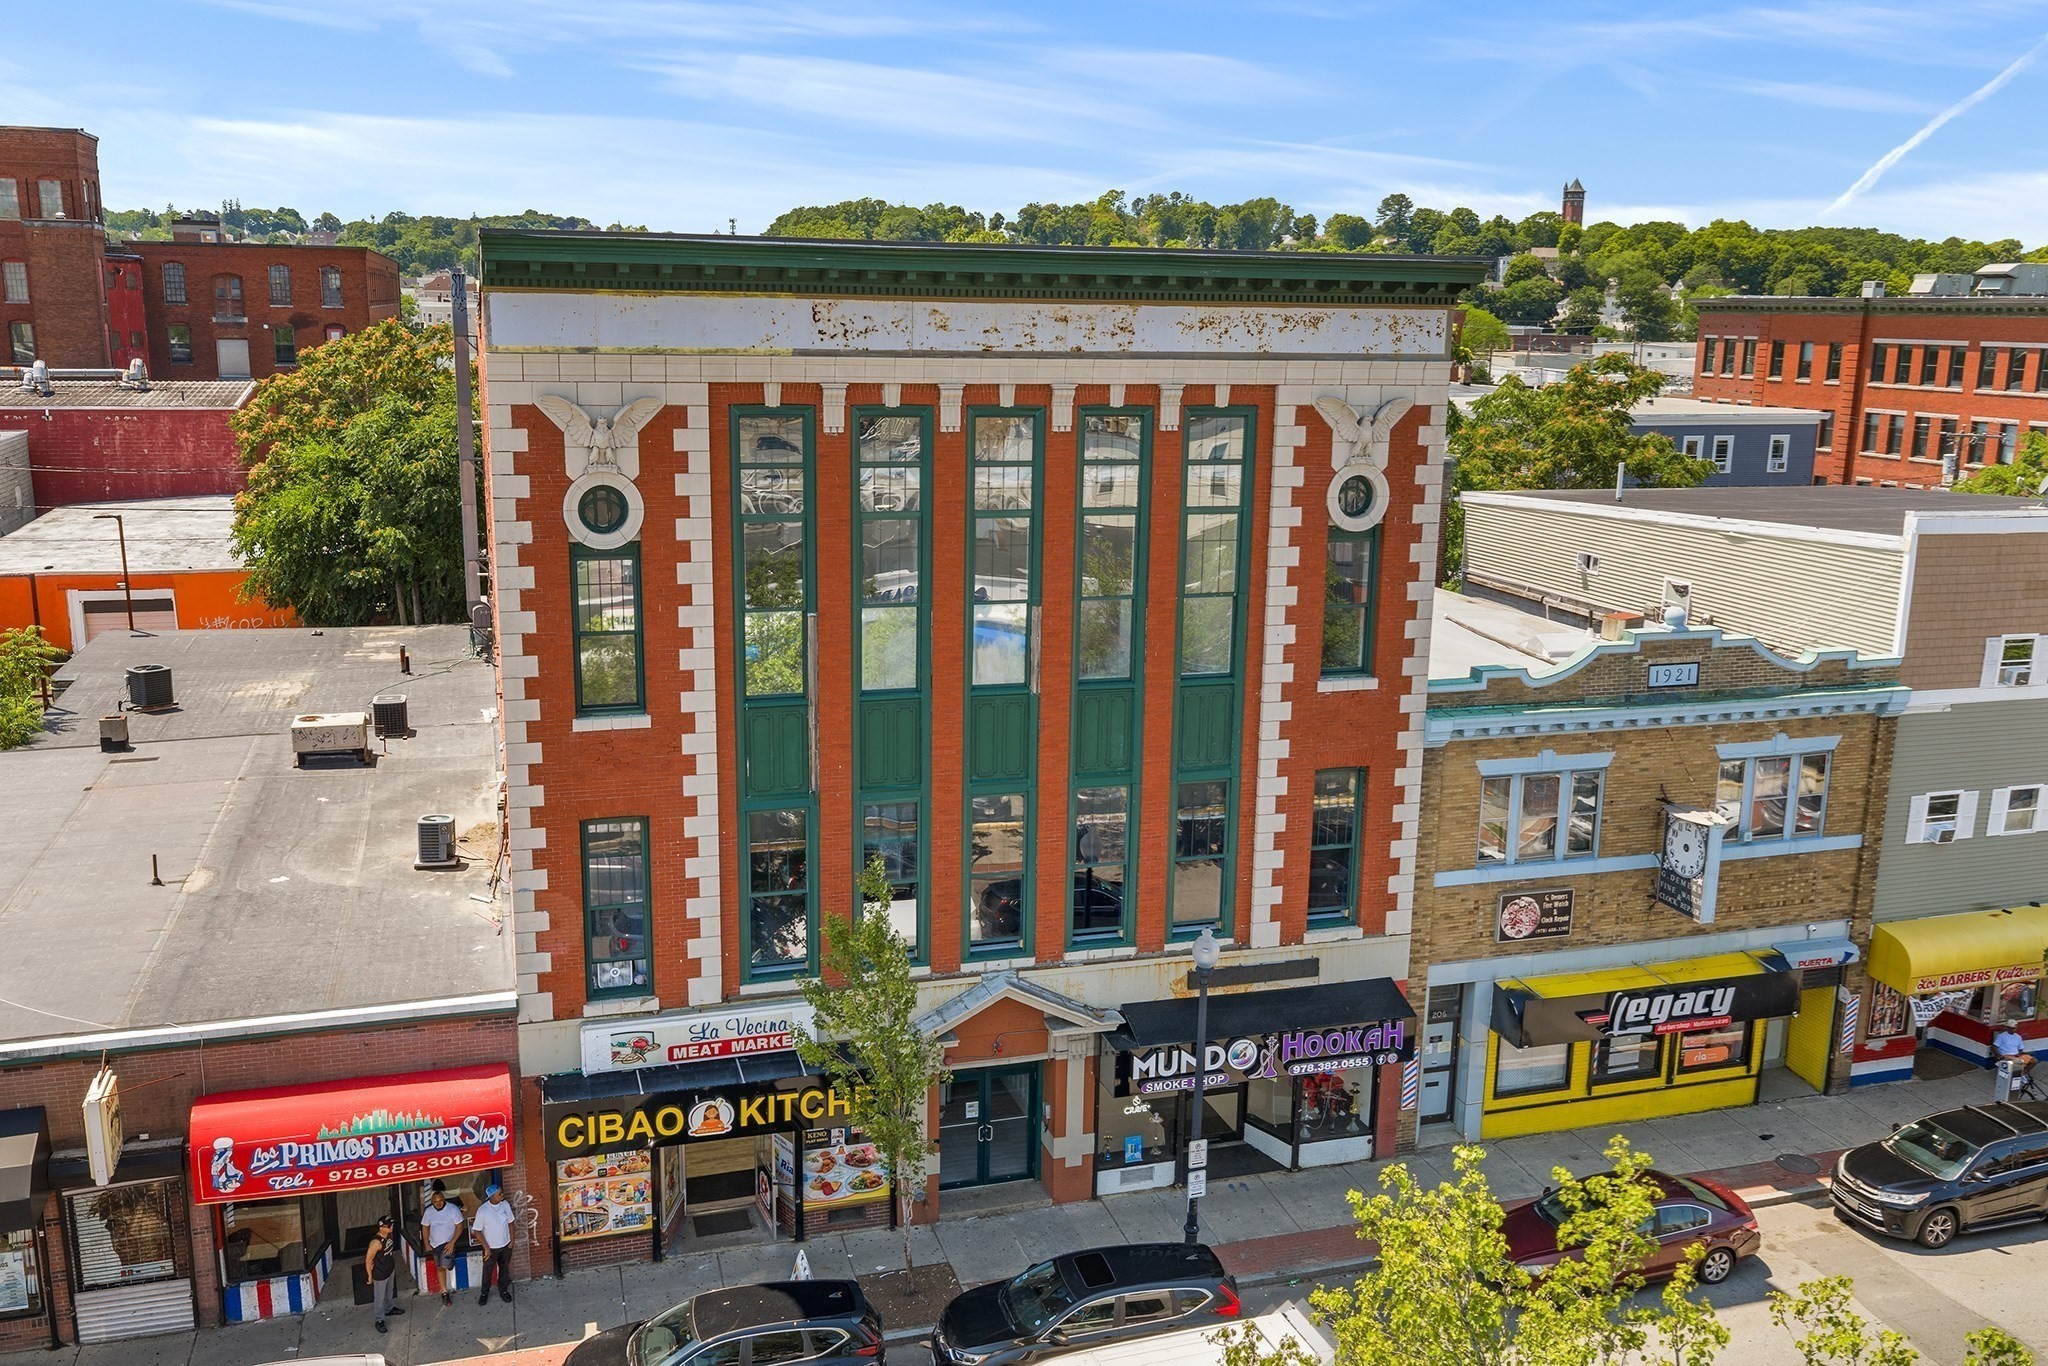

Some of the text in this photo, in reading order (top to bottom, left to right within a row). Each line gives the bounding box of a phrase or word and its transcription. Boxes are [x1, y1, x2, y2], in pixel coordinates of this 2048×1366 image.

[1655, 668, 1692, 683] 1921
[1660, 880, 1676, 894] FINE
[1670, 874, 1702, 895] DEMERS
[1553, 900, 1569, 908] Watch
[1658, 891, 1678, 906] CLOCK
[1554, 915, 1570, 923] Repair
[1797, 957, 1833, 967] PUERTA
[1916, 978, 1937, 991] Los
[1940, 970, 1991, 986] BARBERS
[1431, 1010, 1448, 1019] 206
[1600, 986, 1736, 1037] Legacy
[688, 1017, 788, 1042] La Vecina
[672, 1034, 794, 1060] MEAT MARKE
[1283, 1021, 1404, 1064] HOOKAH
[1292, 1056, 1369, 1075] 978.382.0555
[1145, 1080, 1189, 1093] SMOKE
[558, 1106, 685, 1148] CIBAO
[807, 1130, 827, 1139] KENO
[250, 1116, 510, 1172] Los PRIMOS BARBER Shop
[780, 1158, 794, 1176] Ria
